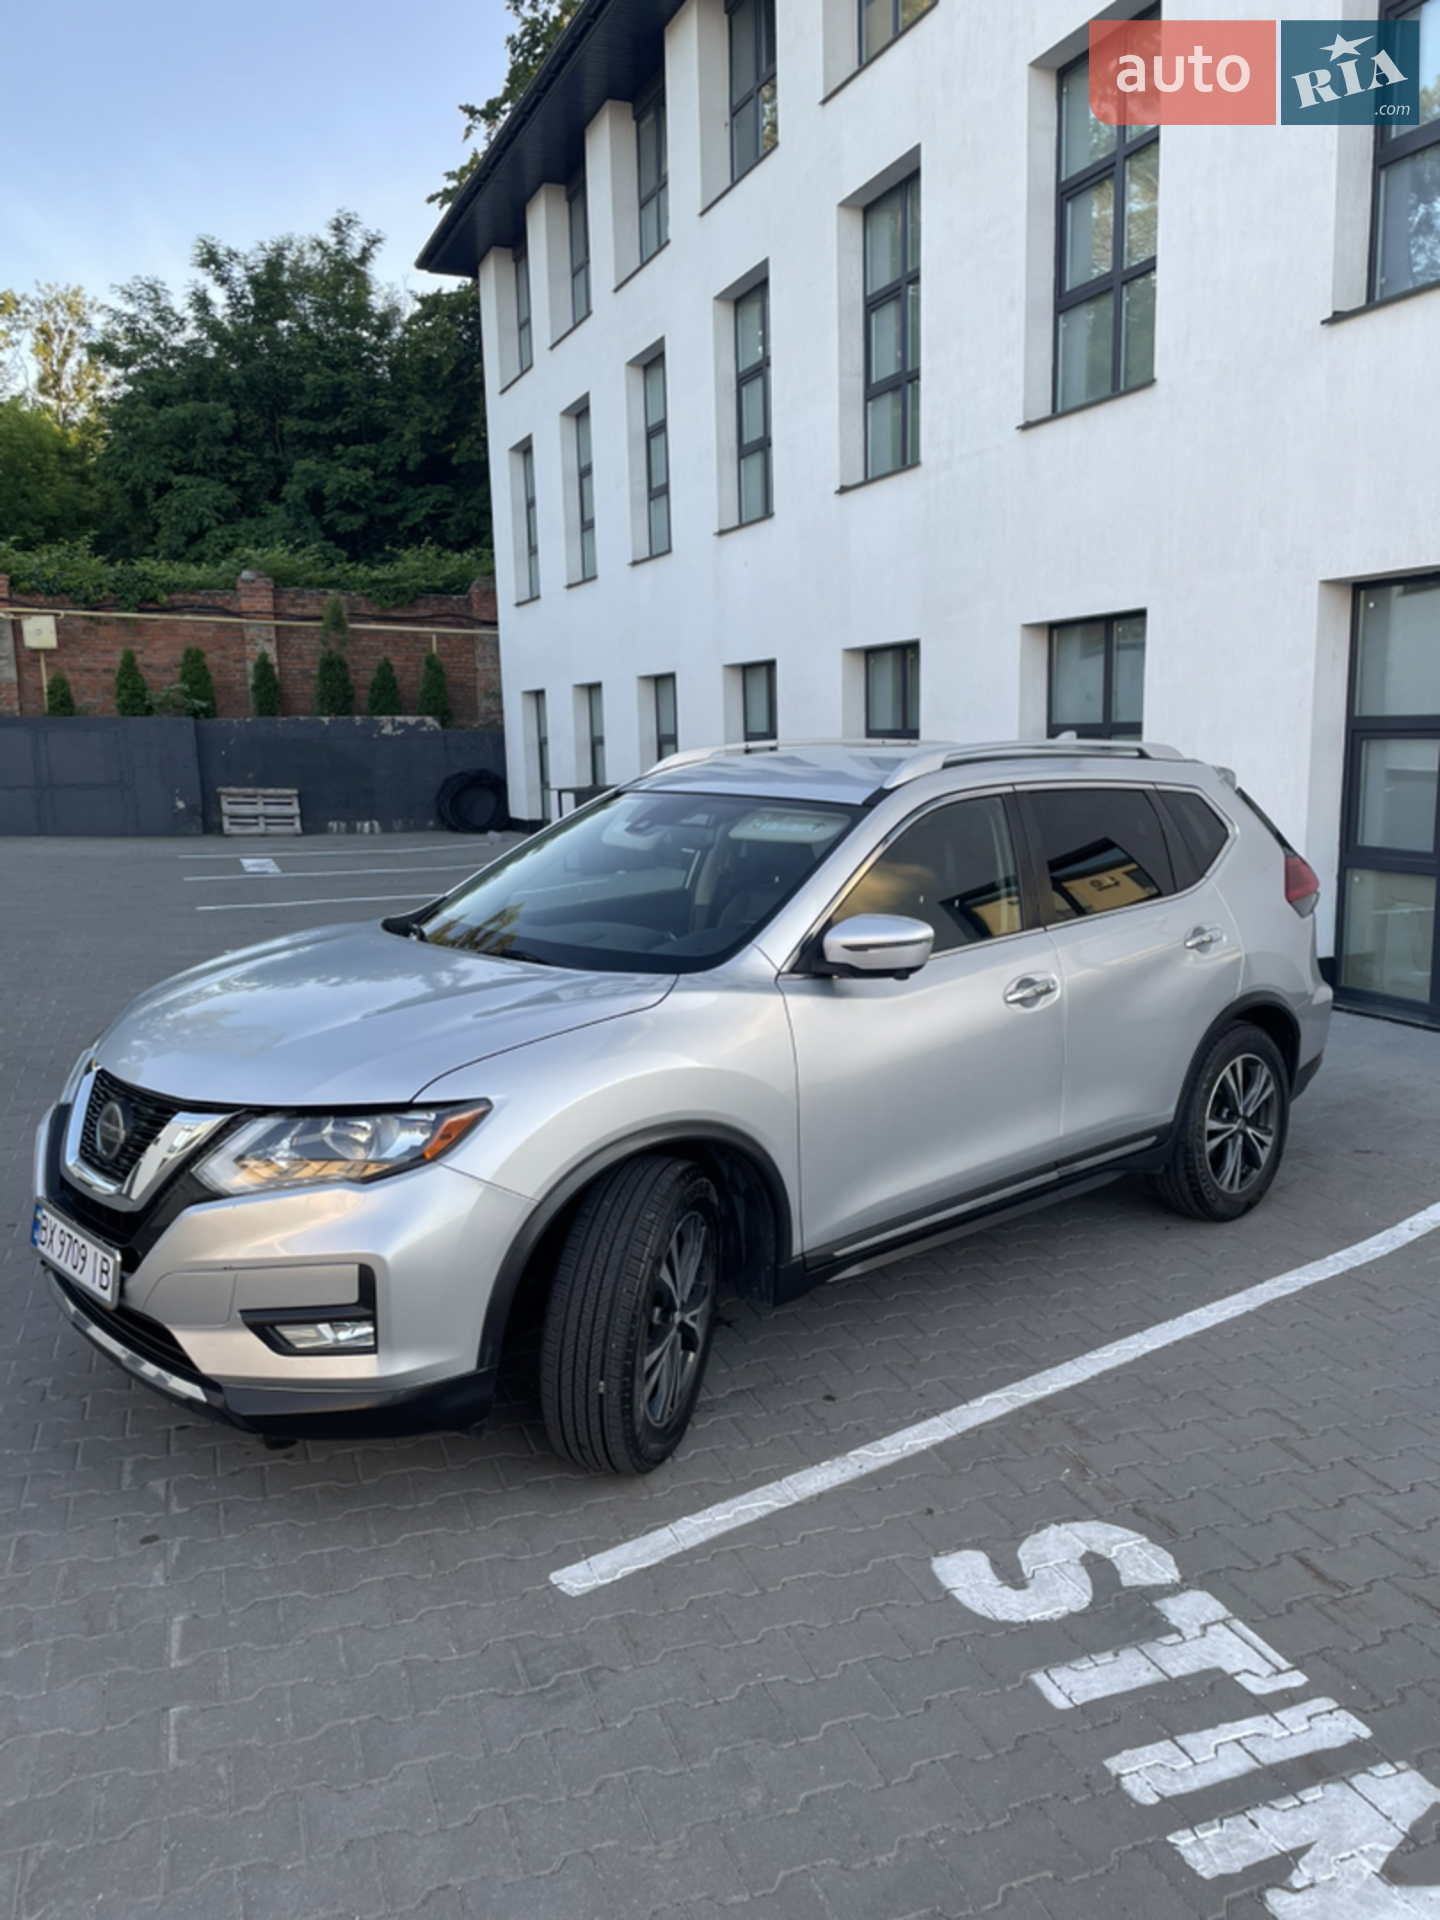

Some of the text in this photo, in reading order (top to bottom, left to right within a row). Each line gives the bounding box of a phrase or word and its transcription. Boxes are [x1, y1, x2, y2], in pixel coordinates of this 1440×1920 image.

[39, 1213, 111, 1291] BX 9709 IB
